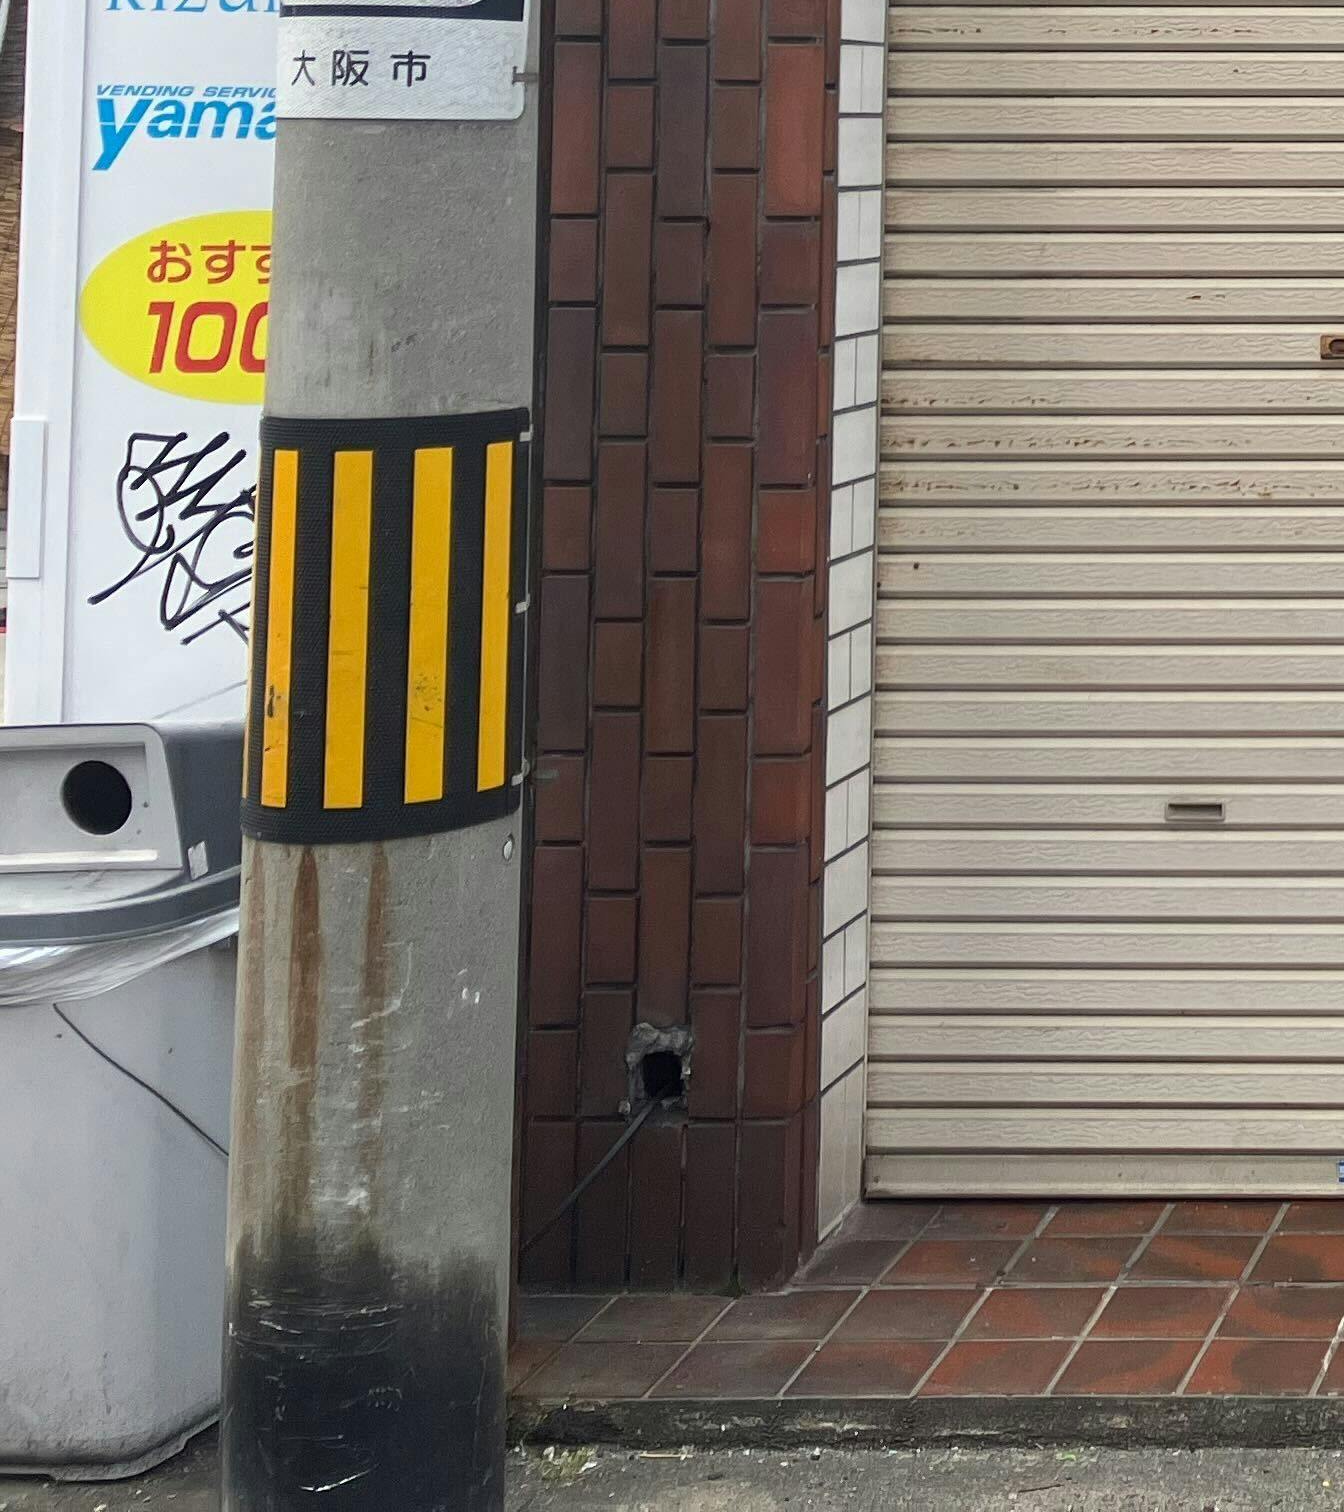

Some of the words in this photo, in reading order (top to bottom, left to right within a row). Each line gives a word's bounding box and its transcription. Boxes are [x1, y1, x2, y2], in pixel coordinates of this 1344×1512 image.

[291, 50, 431, 88] 大阪市
[96, 85, 194, 96] VENDING
